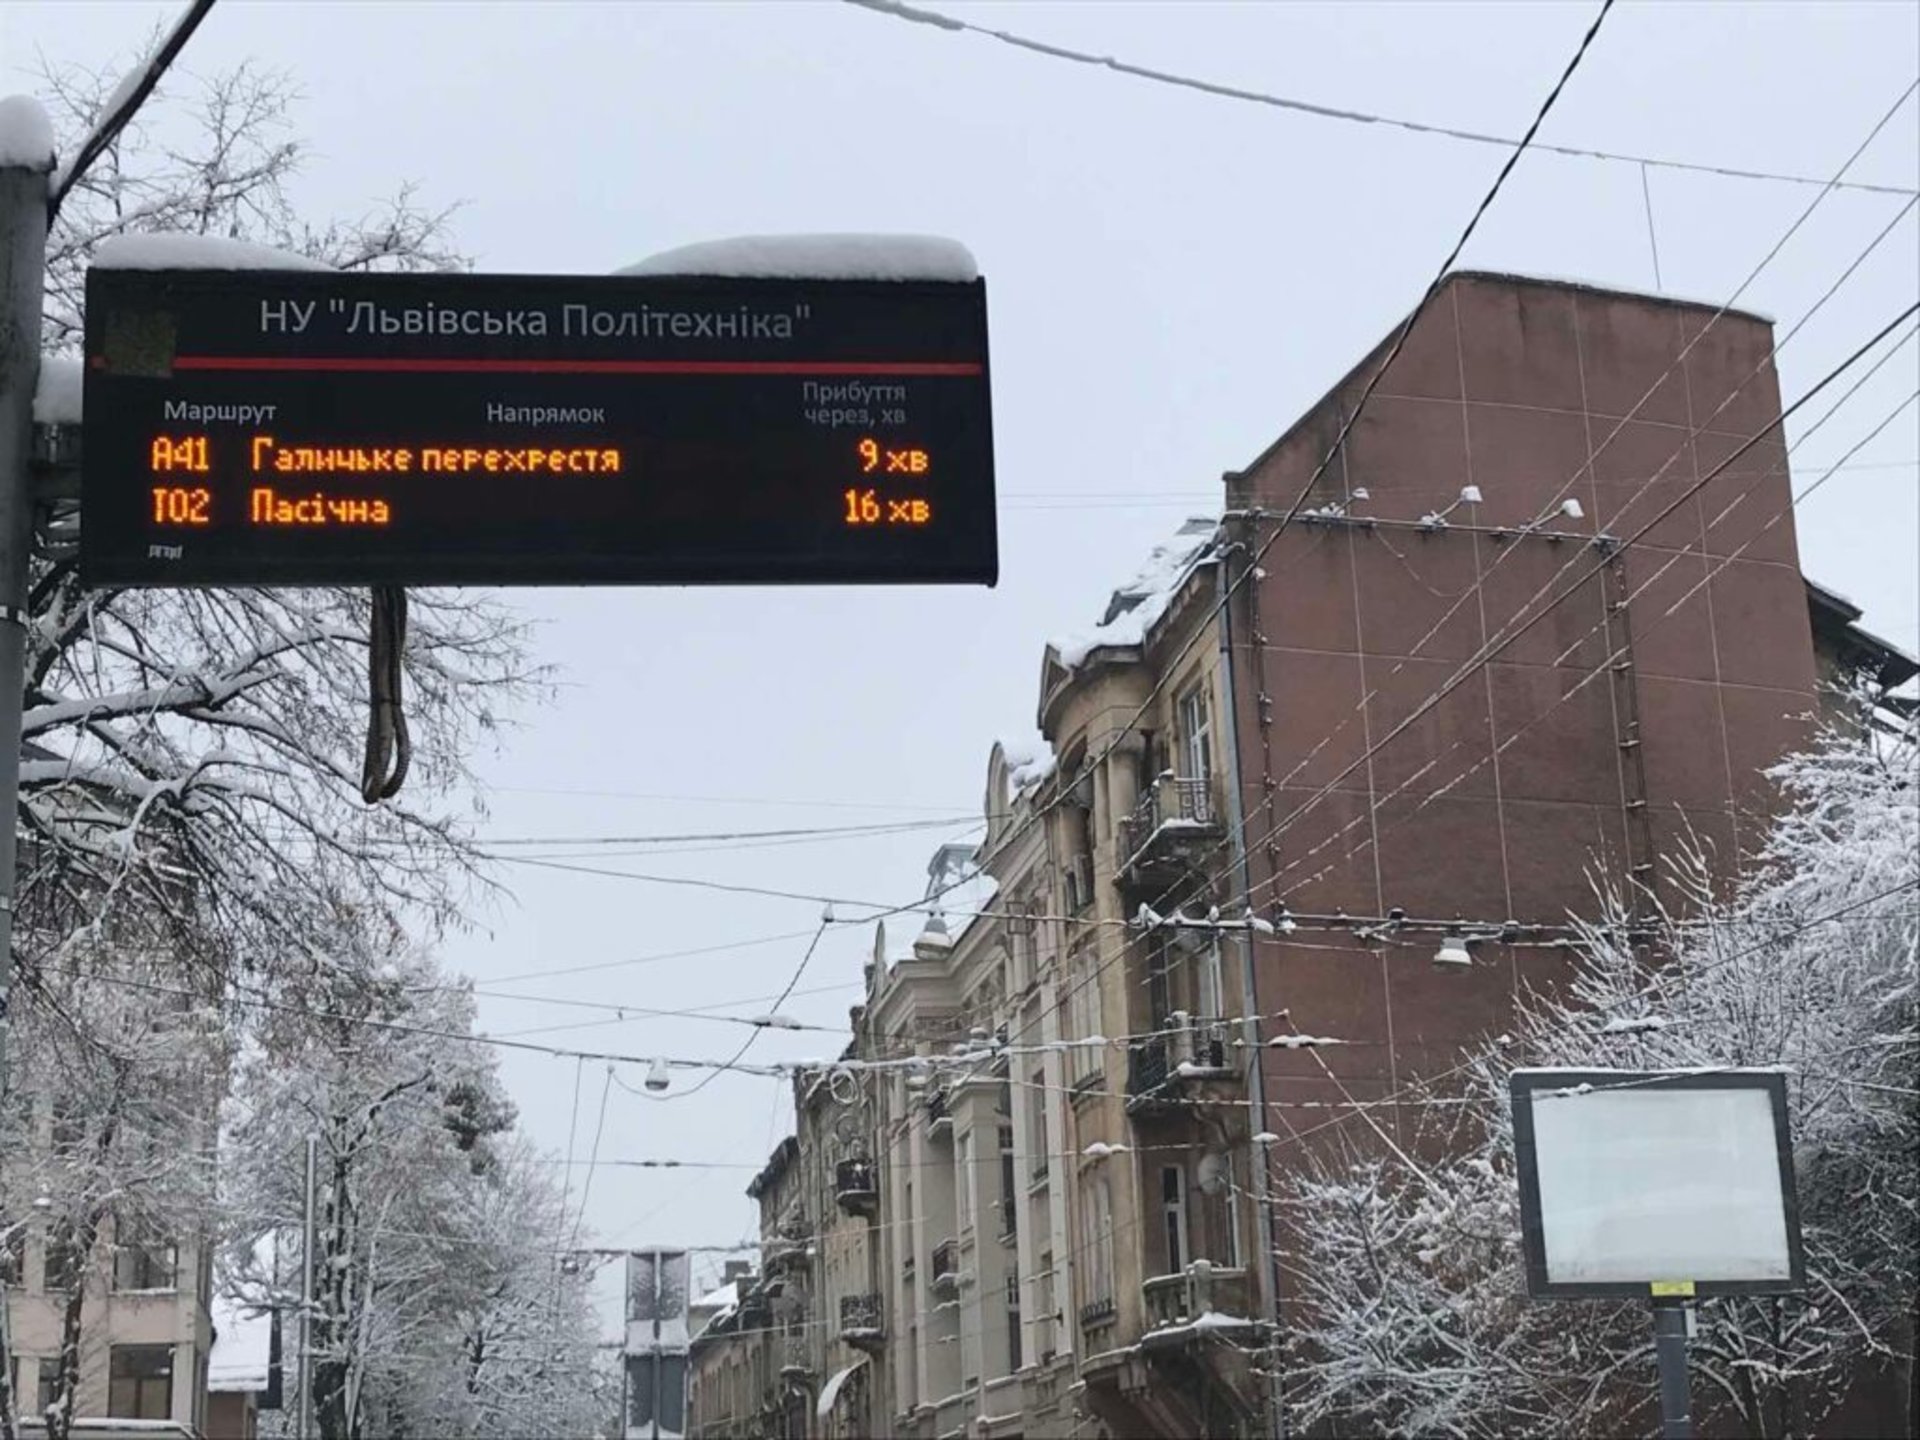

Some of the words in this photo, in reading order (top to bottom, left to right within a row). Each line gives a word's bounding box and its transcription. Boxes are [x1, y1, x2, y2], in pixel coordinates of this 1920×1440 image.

[261, 299, 317, 333] НУ
[329, 299, 548, 336] "Львівська
[563, 304, 811, 338] Політехніка"
[803, 381, 906, 403] Прибуття
[164, 401, 277, 425] Маршрут
[487, 403, 606, 426] Напрямок
[805, 408, 876, 427] через,
[880, 409, 906, 425] хв
[422, 448, 620, 472] перехрестя
[859, 438, 879, 472] 9
[886, 449, 929, 472] хв
[252, 489, 389, 523] Пасічна
[845, 490, 880, 523] 16
[888, 500, 931, 523] хв
